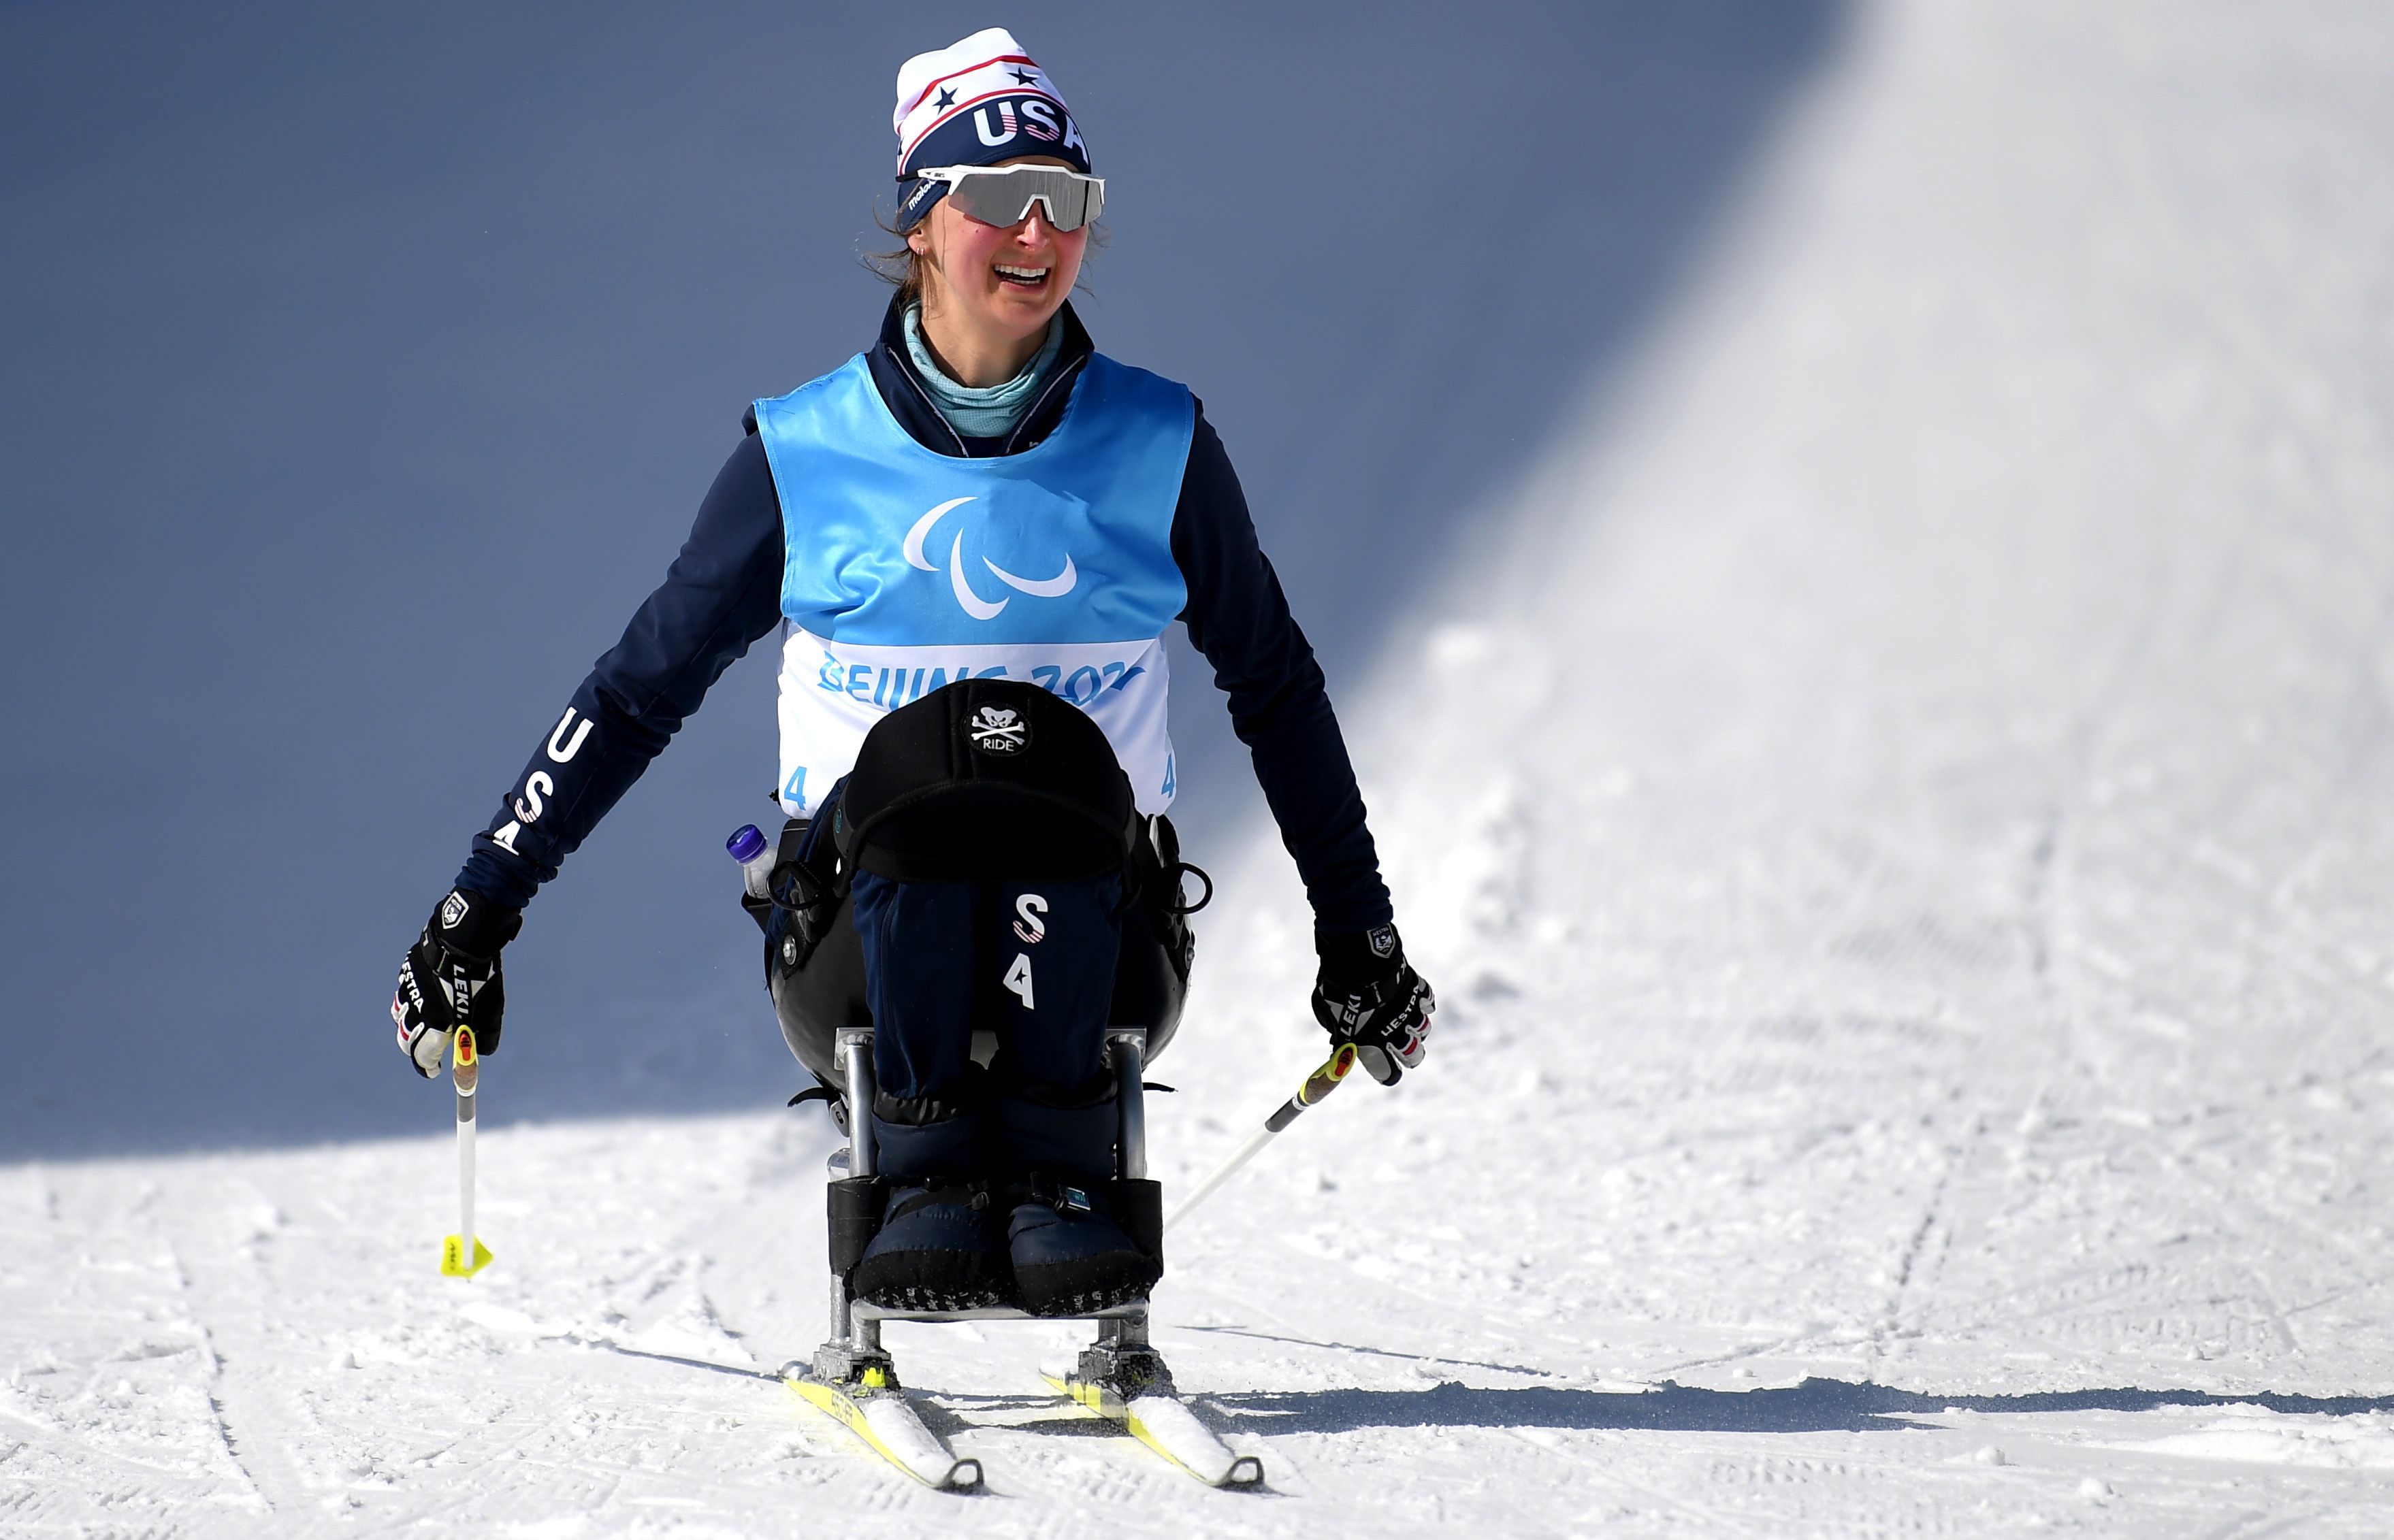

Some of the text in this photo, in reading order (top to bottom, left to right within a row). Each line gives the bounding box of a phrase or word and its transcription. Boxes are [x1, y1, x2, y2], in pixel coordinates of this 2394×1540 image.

[973, 100, 1088, 165] USA
[983, 738, 1014, 752] RIDE
[783, 766, 807, 810] 4
[1161, 753, 1175, 798] 4
[453, 964, 469, 1015] LEKI
[1340, 994, 1361, 1036] LEKI
